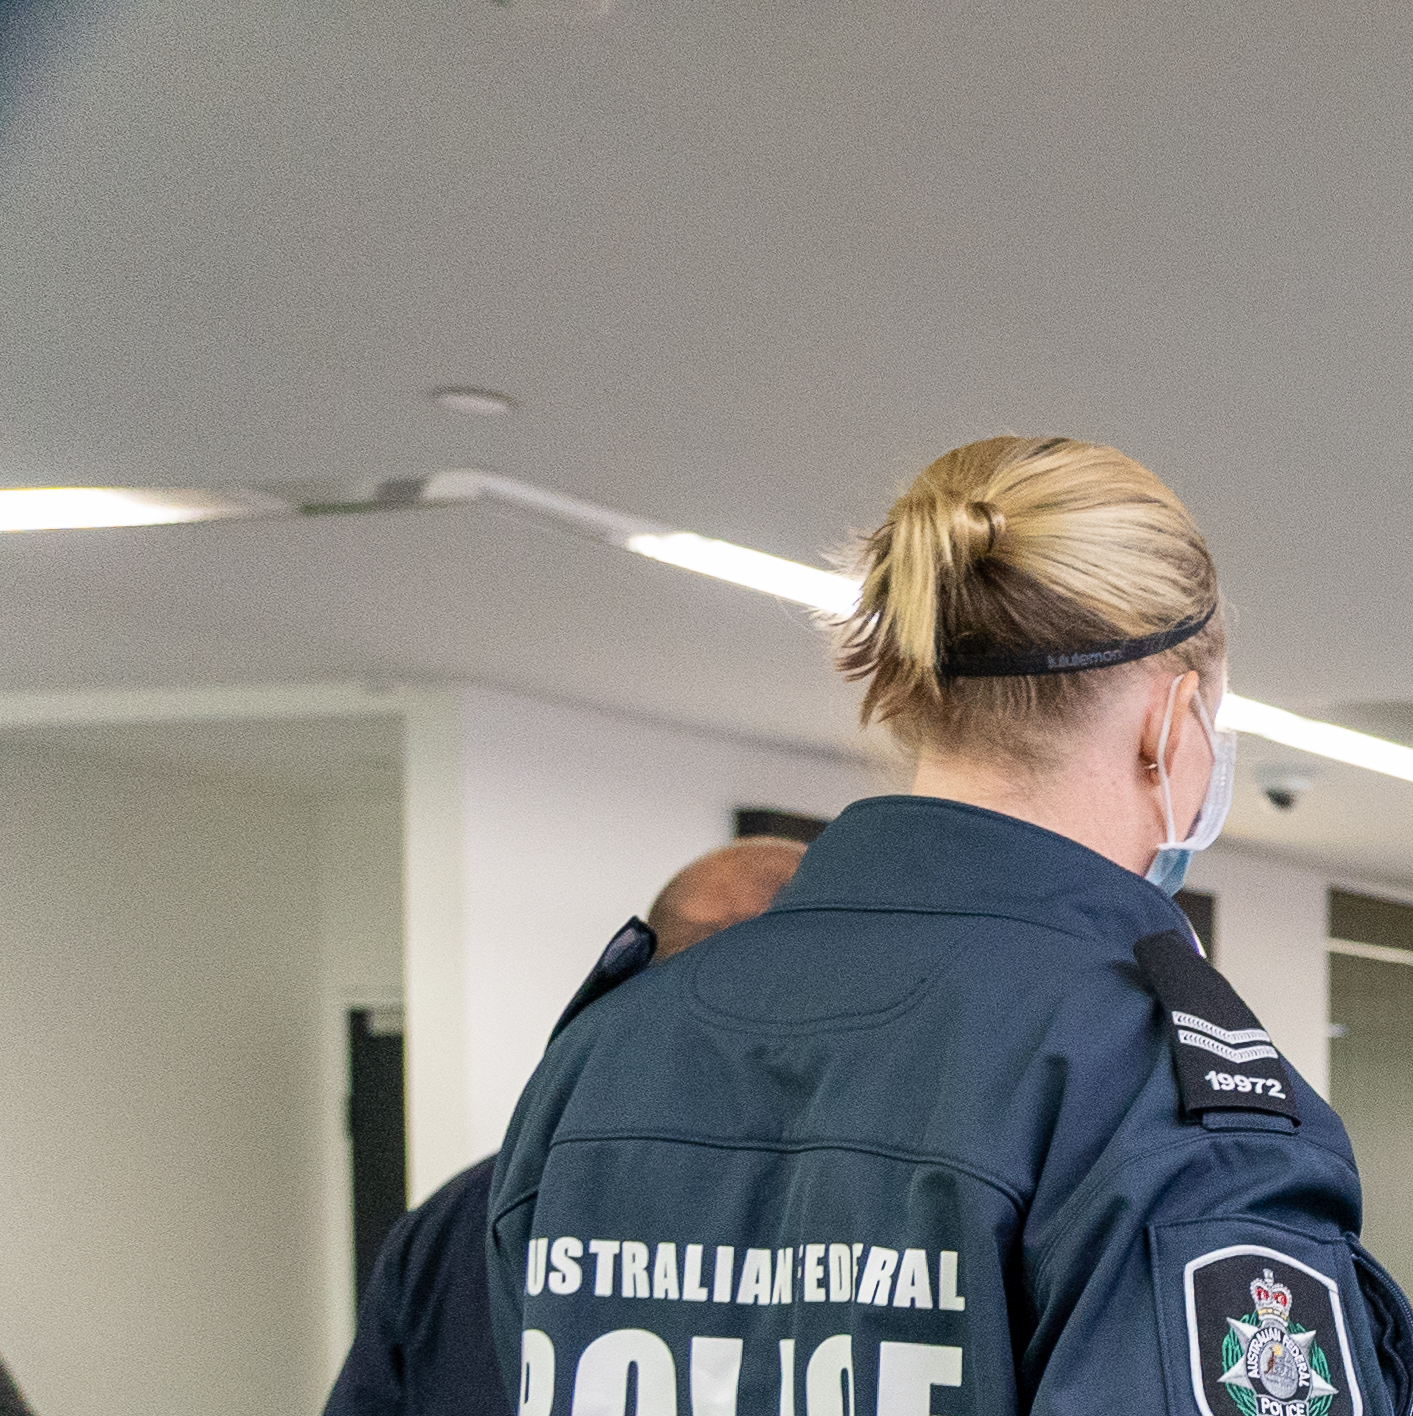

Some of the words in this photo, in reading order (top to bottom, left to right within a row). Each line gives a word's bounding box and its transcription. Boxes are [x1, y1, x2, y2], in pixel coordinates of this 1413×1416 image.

[1205, 1070, 1287, 1100] 19972
[524, 1236, 794, 1306] USTRALIAN
[797, 1243, 966, 1311] EDRAL
[1247, 1326, 1281, 1379] AUSTRALIAN
[1282, 1335, 1311, 1388] FEDERAL
